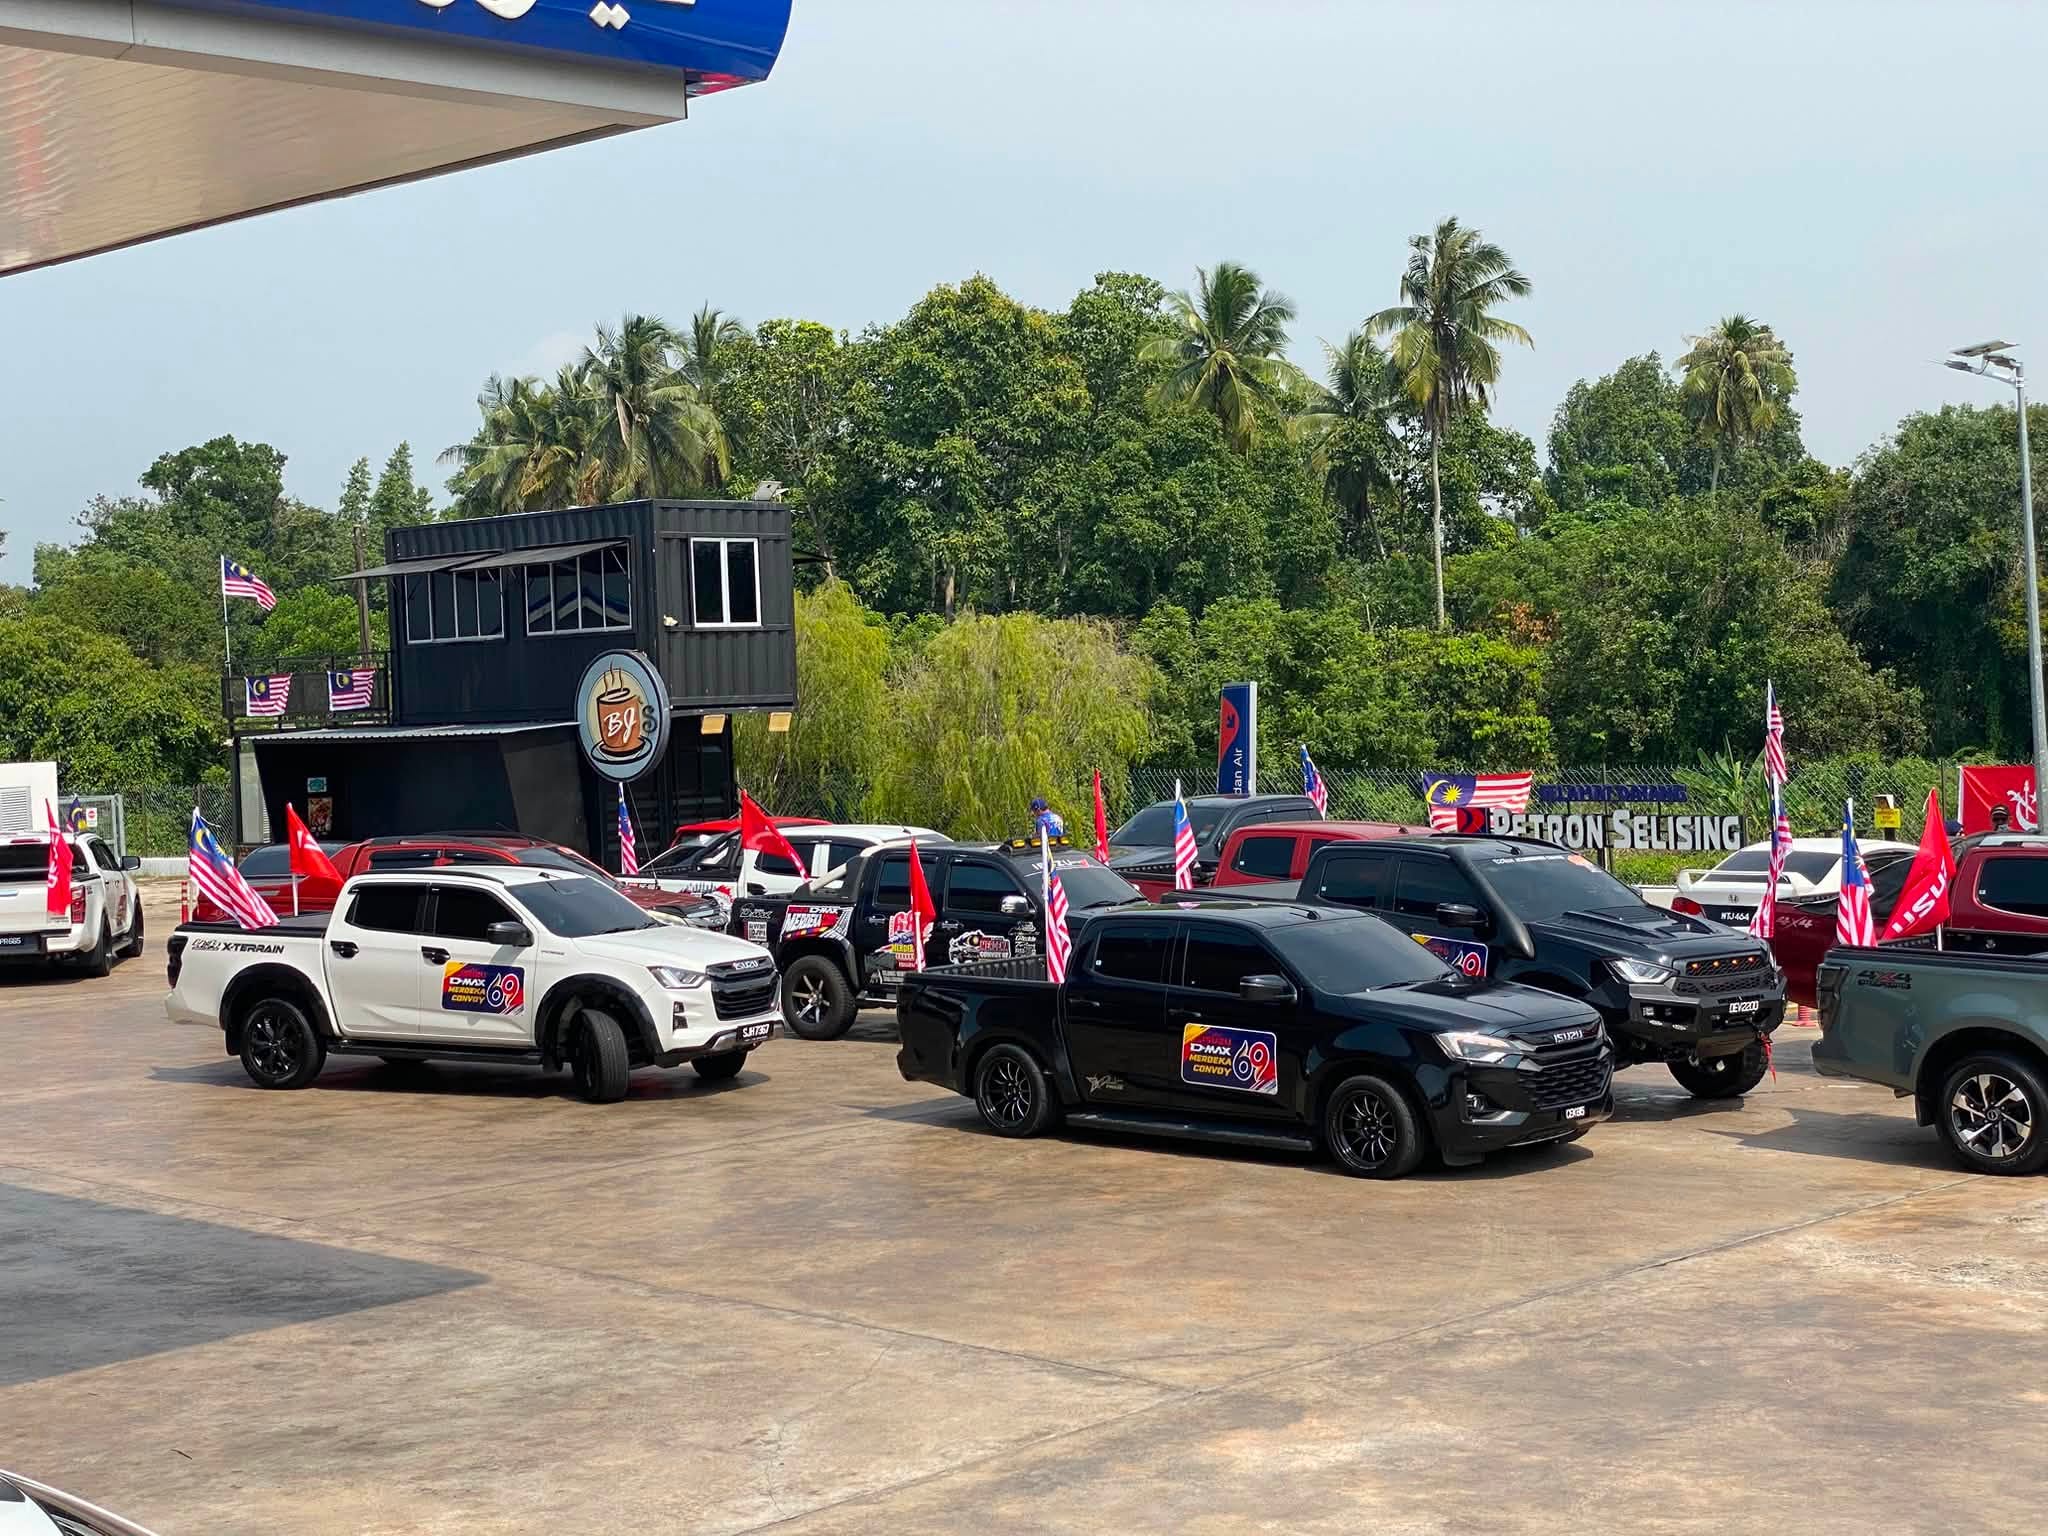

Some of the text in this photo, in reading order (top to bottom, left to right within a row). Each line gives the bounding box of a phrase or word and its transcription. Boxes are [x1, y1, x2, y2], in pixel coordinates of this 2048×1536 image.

[1232, 747, 1243, 767] Air
[1492, 807, 1741, 850] PETRON SELISING
[732, 960, 760, 971] ISUZU
[449, 977, 486, 987] D-MAX
[448, 986, 486, 996] MERDEKA
[486, 972, 520, 1008] 69
[451, 994, 486, 1005] CONVOY
[1553, 1029, 1583, 1044] ISUZU
[1190, 1043, 1232, 1056] D-MAX
[1189, 1053, 1232, 1066] MERDEKA
[1233, 1040, 1270, 1083] 69
[1193, 1064, 1232, 1077] CONVOY
